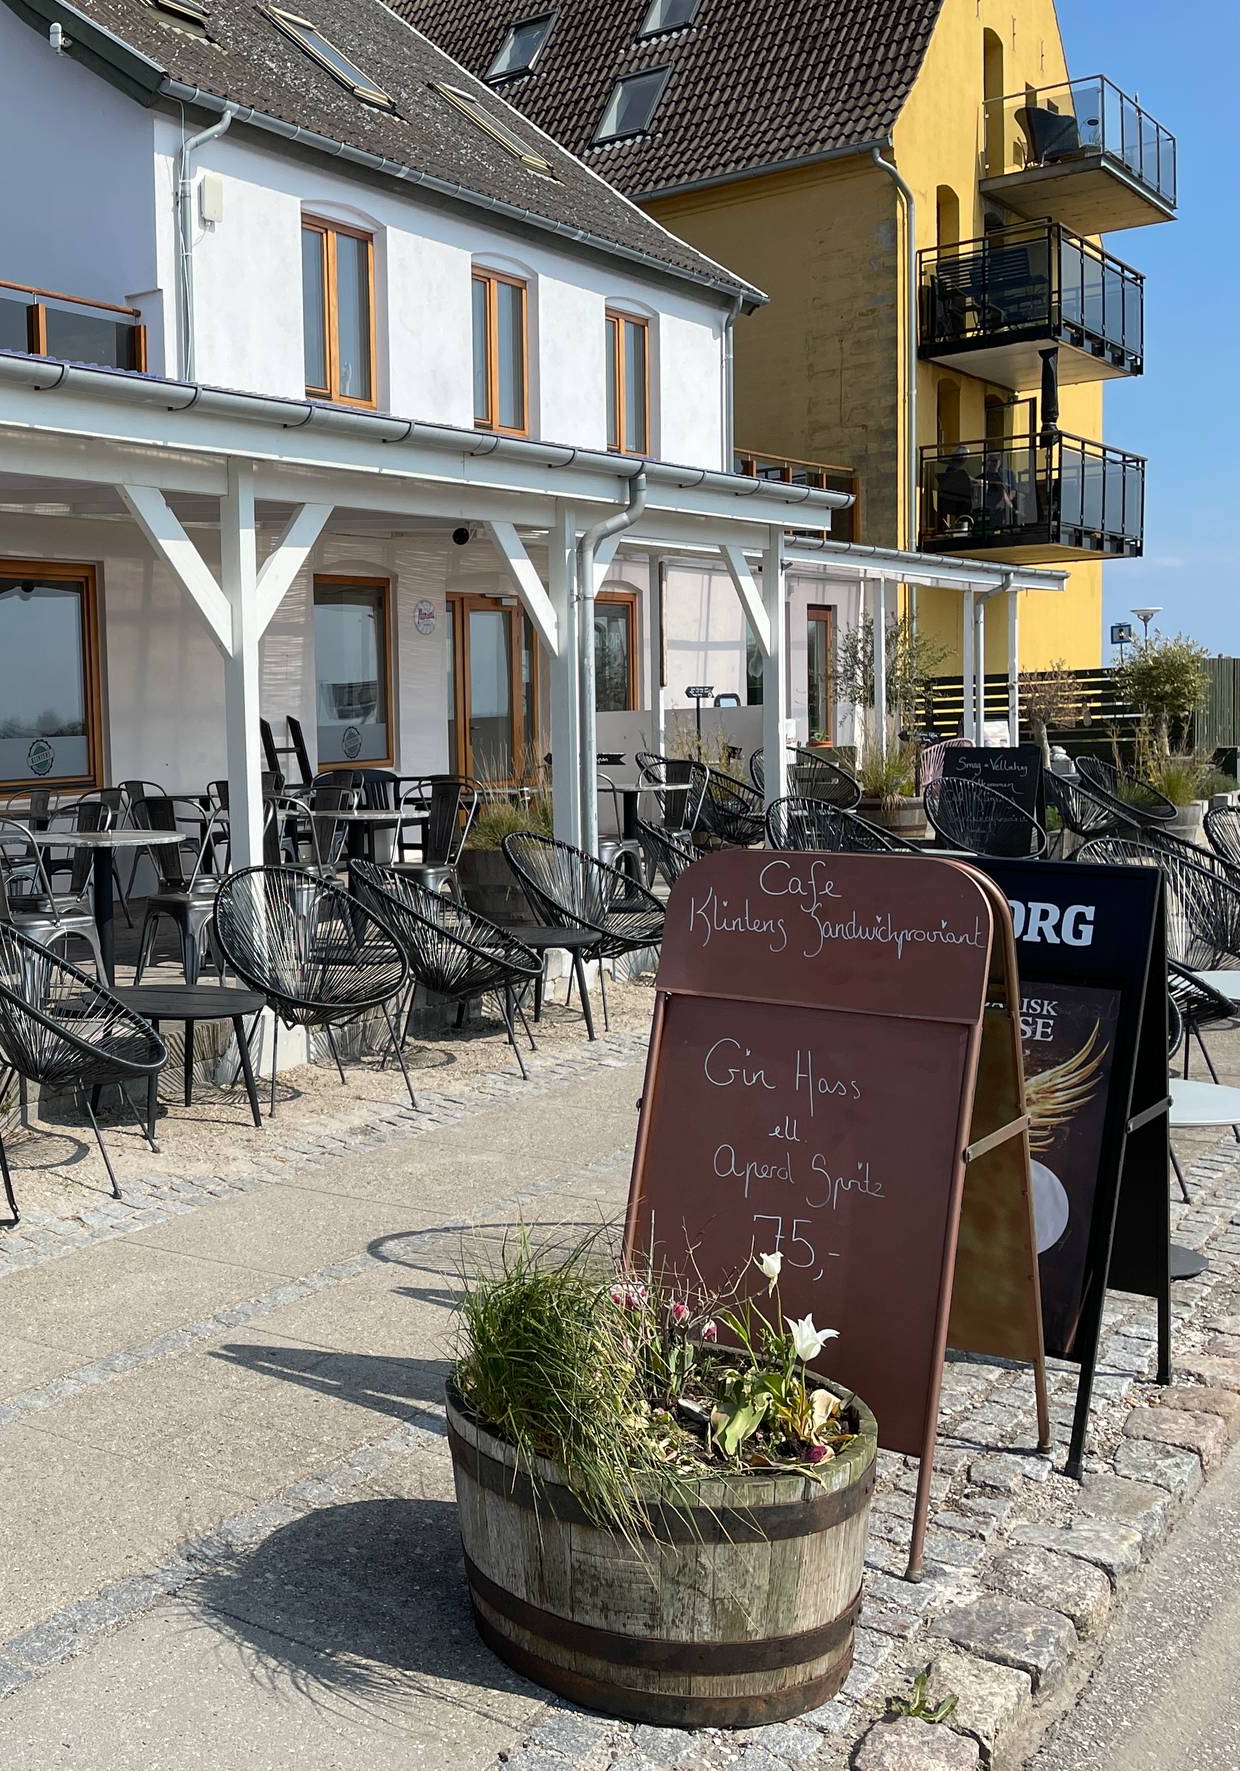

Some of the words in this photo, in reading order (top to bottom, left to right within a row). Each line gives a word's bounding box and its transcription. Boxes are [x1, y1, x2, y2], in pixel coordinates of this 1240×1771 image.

[759, 860, 843, 913] Cafe
[803, 902, 985, 960] Sandwichproviant
[1019, 1015, 1055, 1042] SE
[1020, 997, 1060, 1017] ISK
[704, 1038, 777, 1090] Gin
[796, 1049, 861, 1117] Hass
[806, 1153, 886, 1210] Spritz
